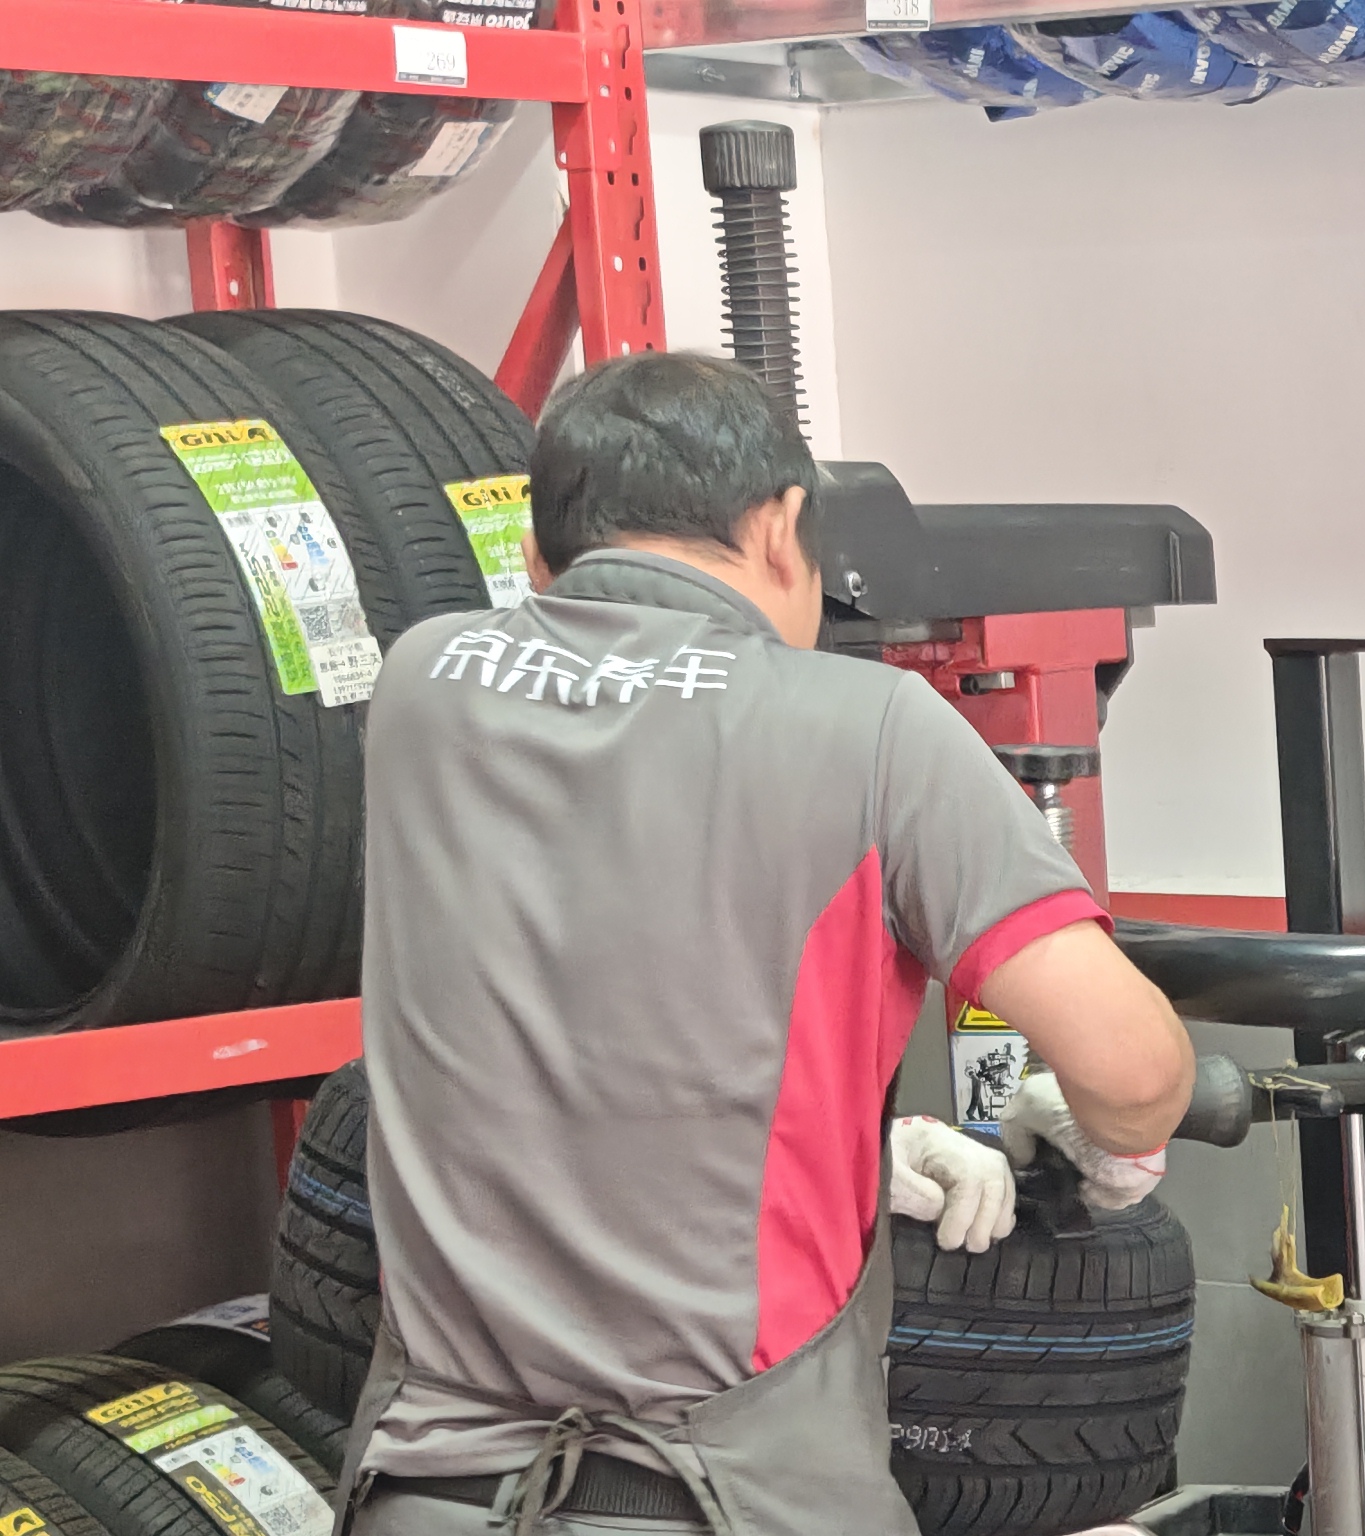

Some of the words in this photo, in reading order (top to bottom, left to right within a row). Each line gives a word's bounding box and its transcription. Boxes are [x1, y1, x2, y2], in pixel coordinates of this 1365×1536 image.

[427, 52, 456, 71] 269
[430, 629, 736, 706] 京东养车
